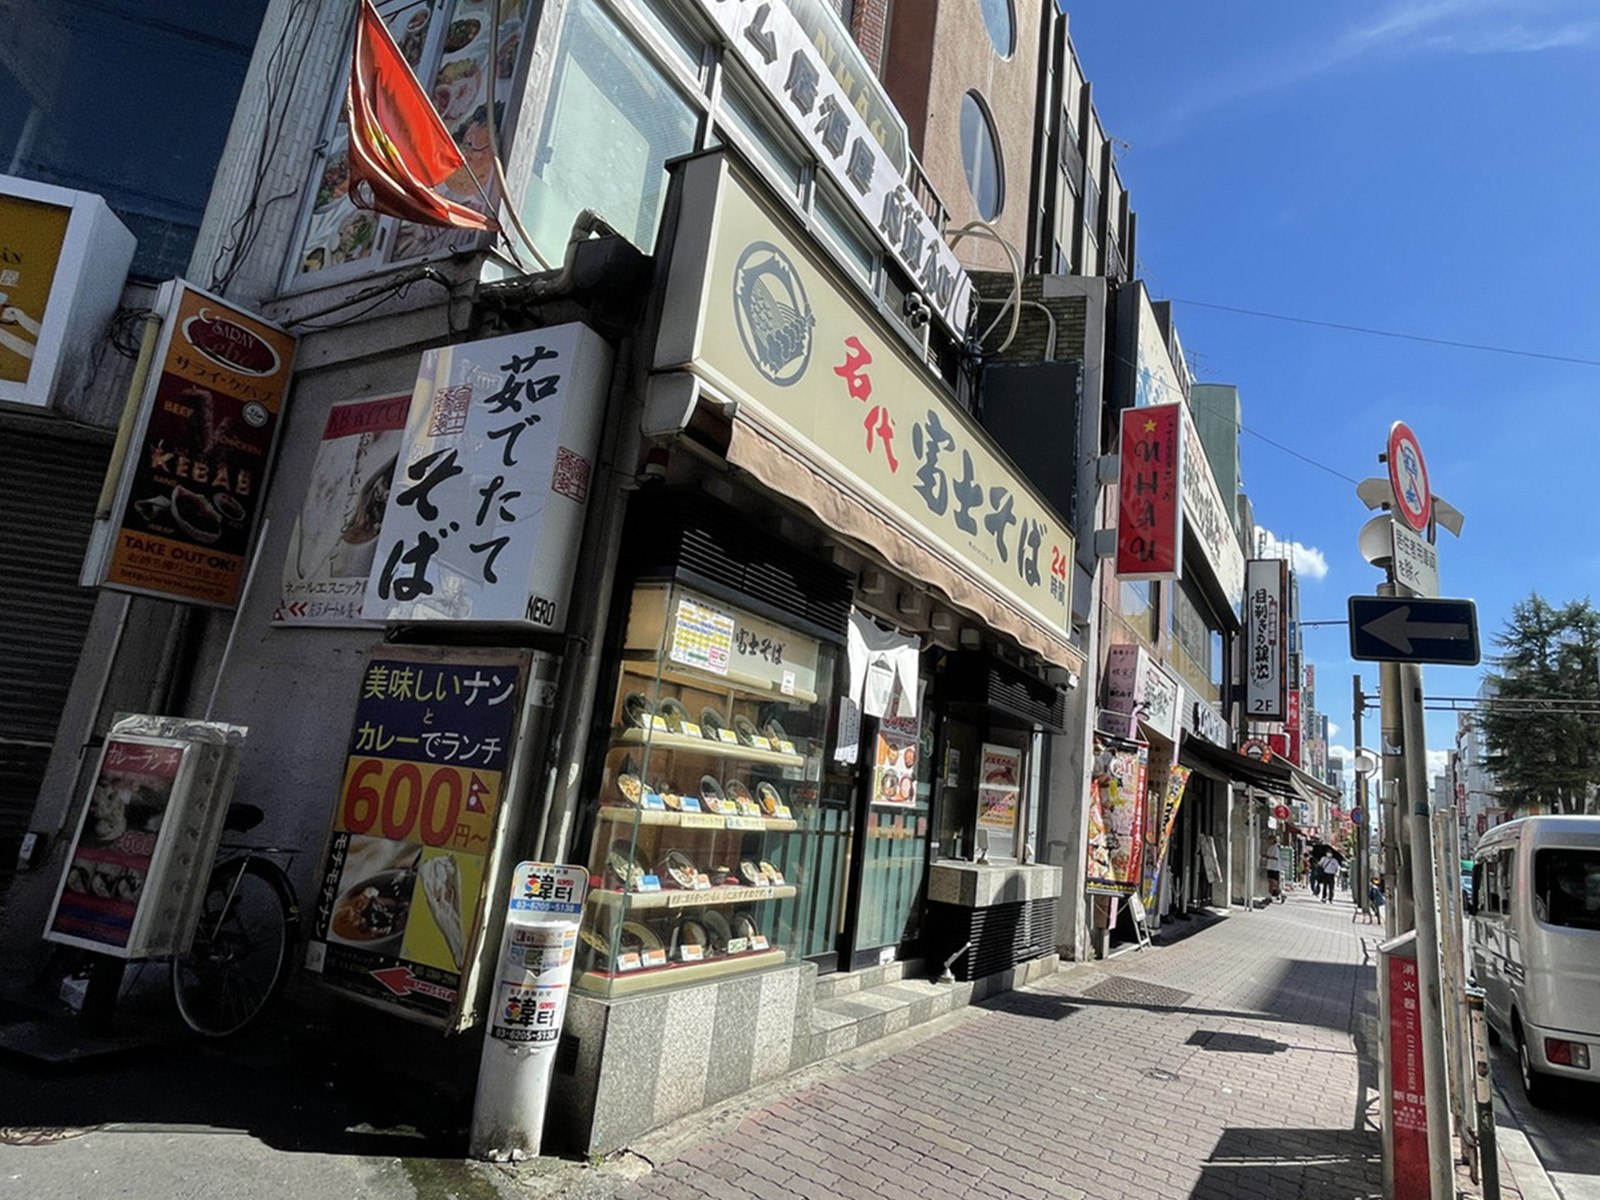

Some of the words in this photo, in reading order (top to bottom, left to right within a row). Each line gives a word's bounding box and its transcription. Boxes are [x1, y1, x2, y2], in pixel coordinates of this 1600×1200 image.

[834, 336, 898, 474] 名代
[151, 448, 251, 497] KEBAB
[468, 346, 562, 585] 茹でたて
[912, 409, 1048, 587] 富士そば
[378, 447, 464, 601] そば
[125, 535, 166, 557] TAKE
[170, 547, 208, 565] OUT
[207, 556, 237, 573] OK!
[1051, 545, 1067, 581] 24
[735, 626, 786, 666] 富士そば
[362, 664, 516, 707] 美味しいナン
[1254, 699, 1273, 712] 2F
[421, 707, 435, 725] と
[354, 721, 503, 766] カレーでランチ
